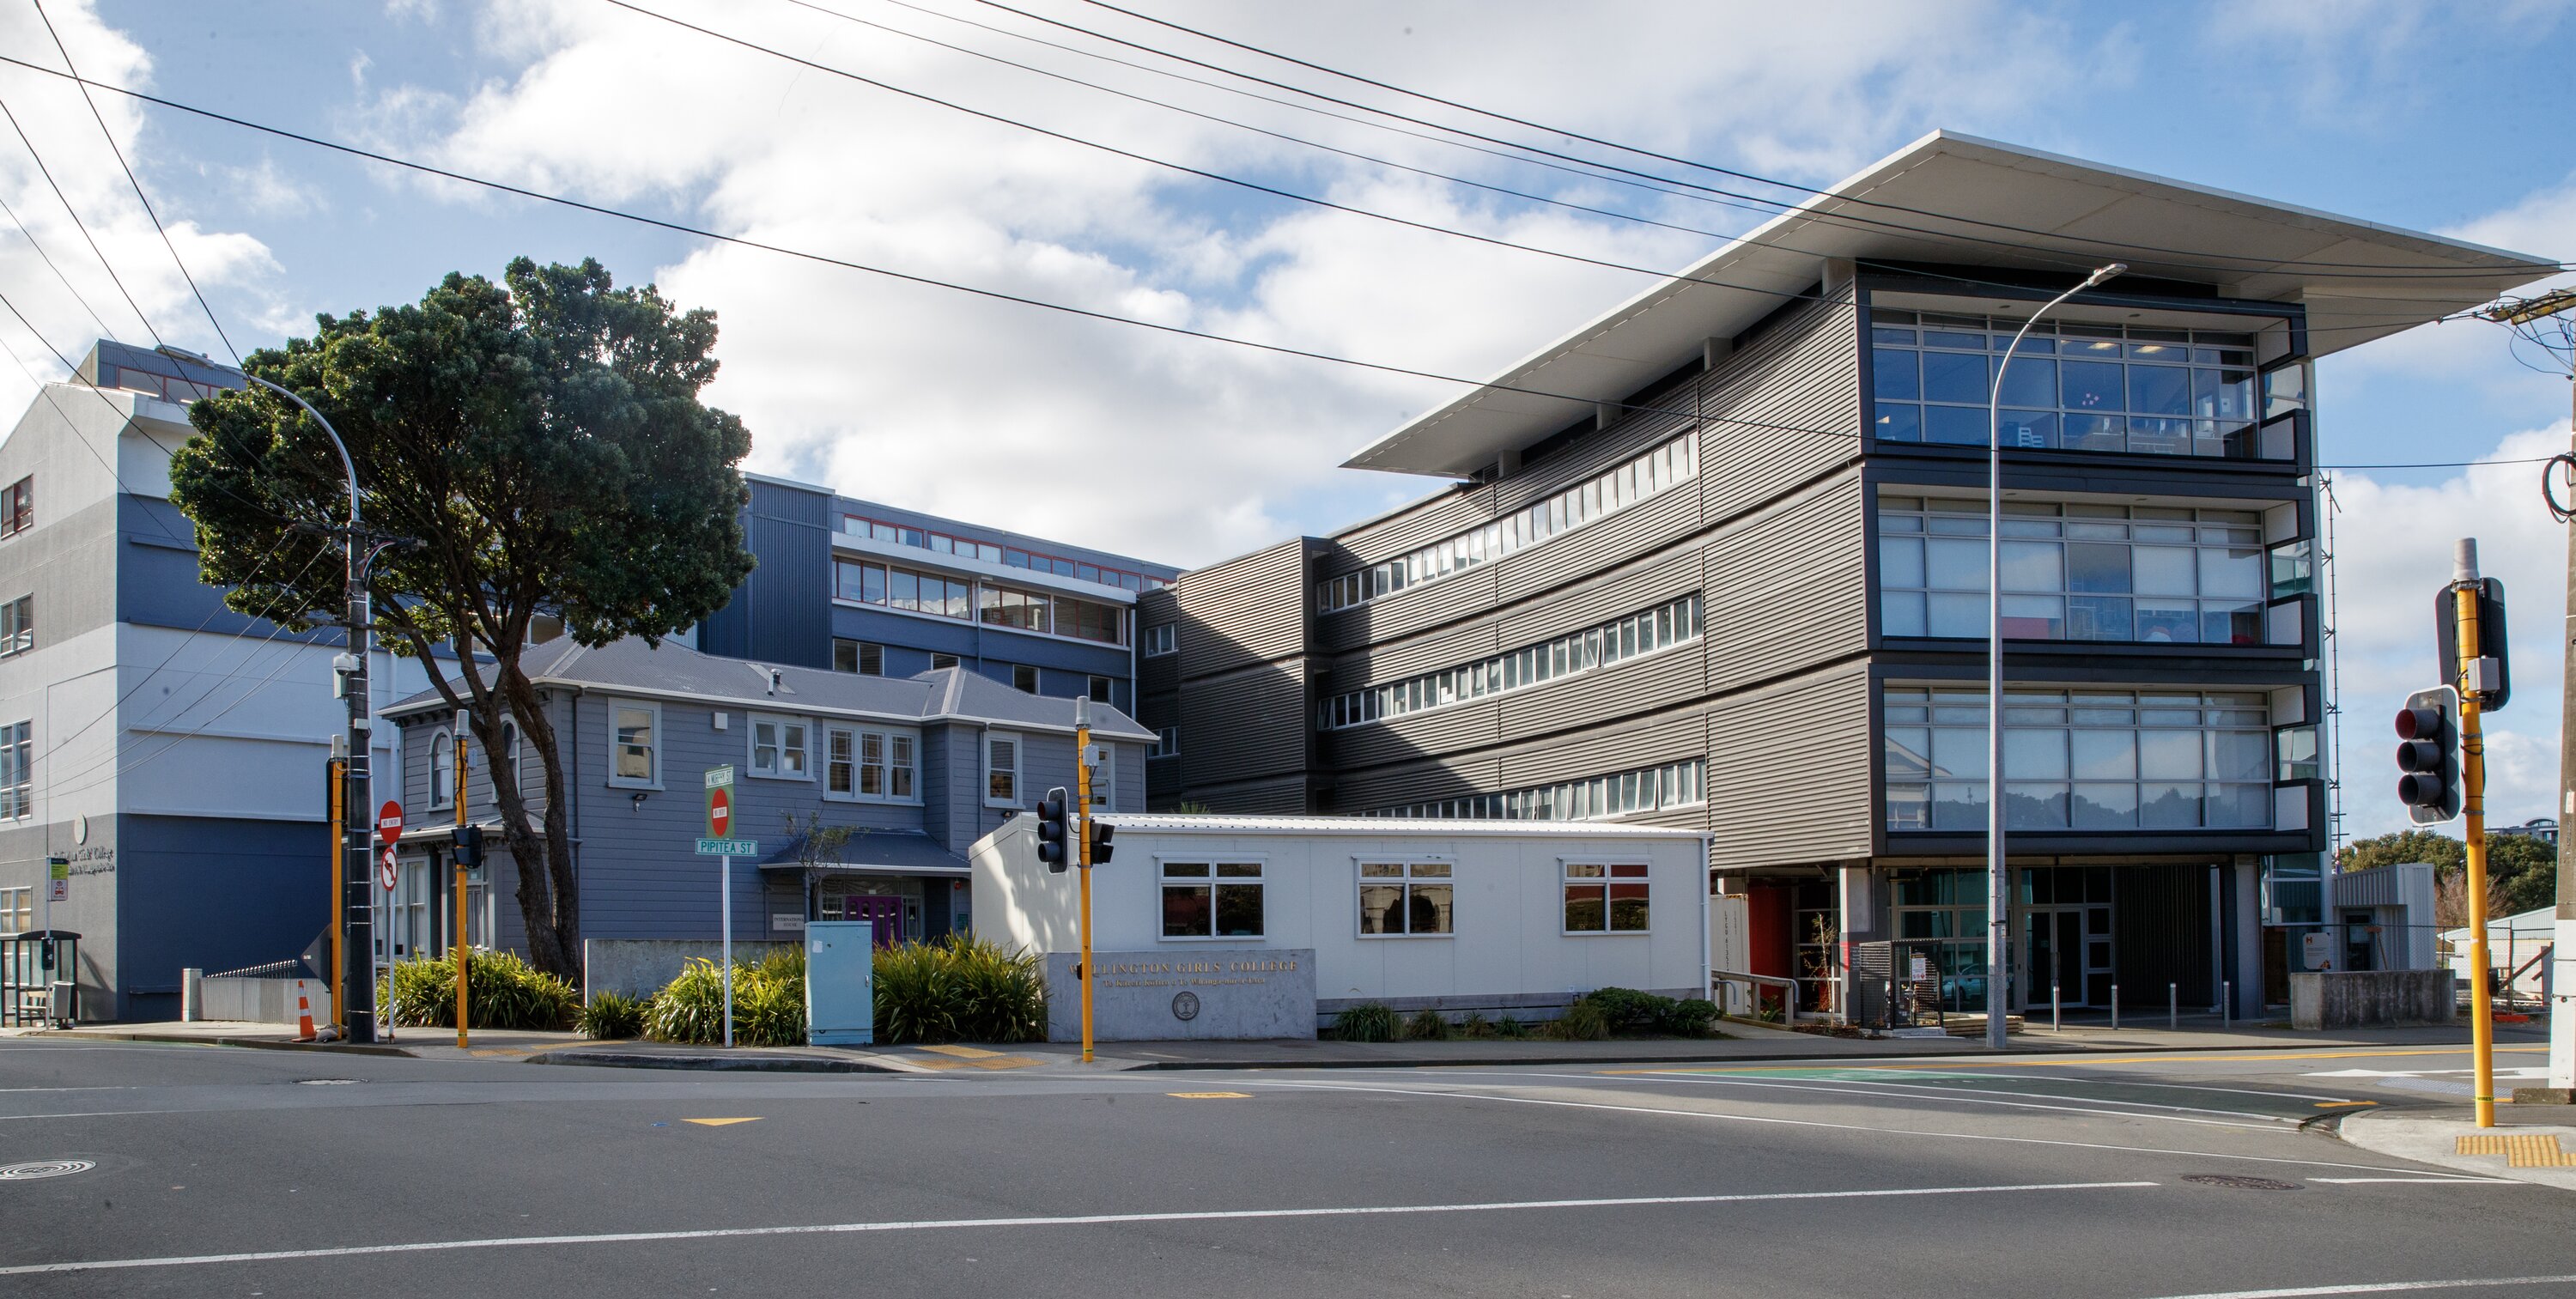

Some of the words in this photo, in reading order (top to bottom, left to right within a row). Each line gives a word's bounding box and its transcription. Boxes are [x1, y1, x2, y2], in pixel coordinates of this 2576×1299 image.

[701, 841, 736, 853] PIPITEA
[740, 843, 751, 853] ST
[1068, 962, 1170, 975] WLLINGTON
[1230, 961, 1297, 973] COLLEGE
